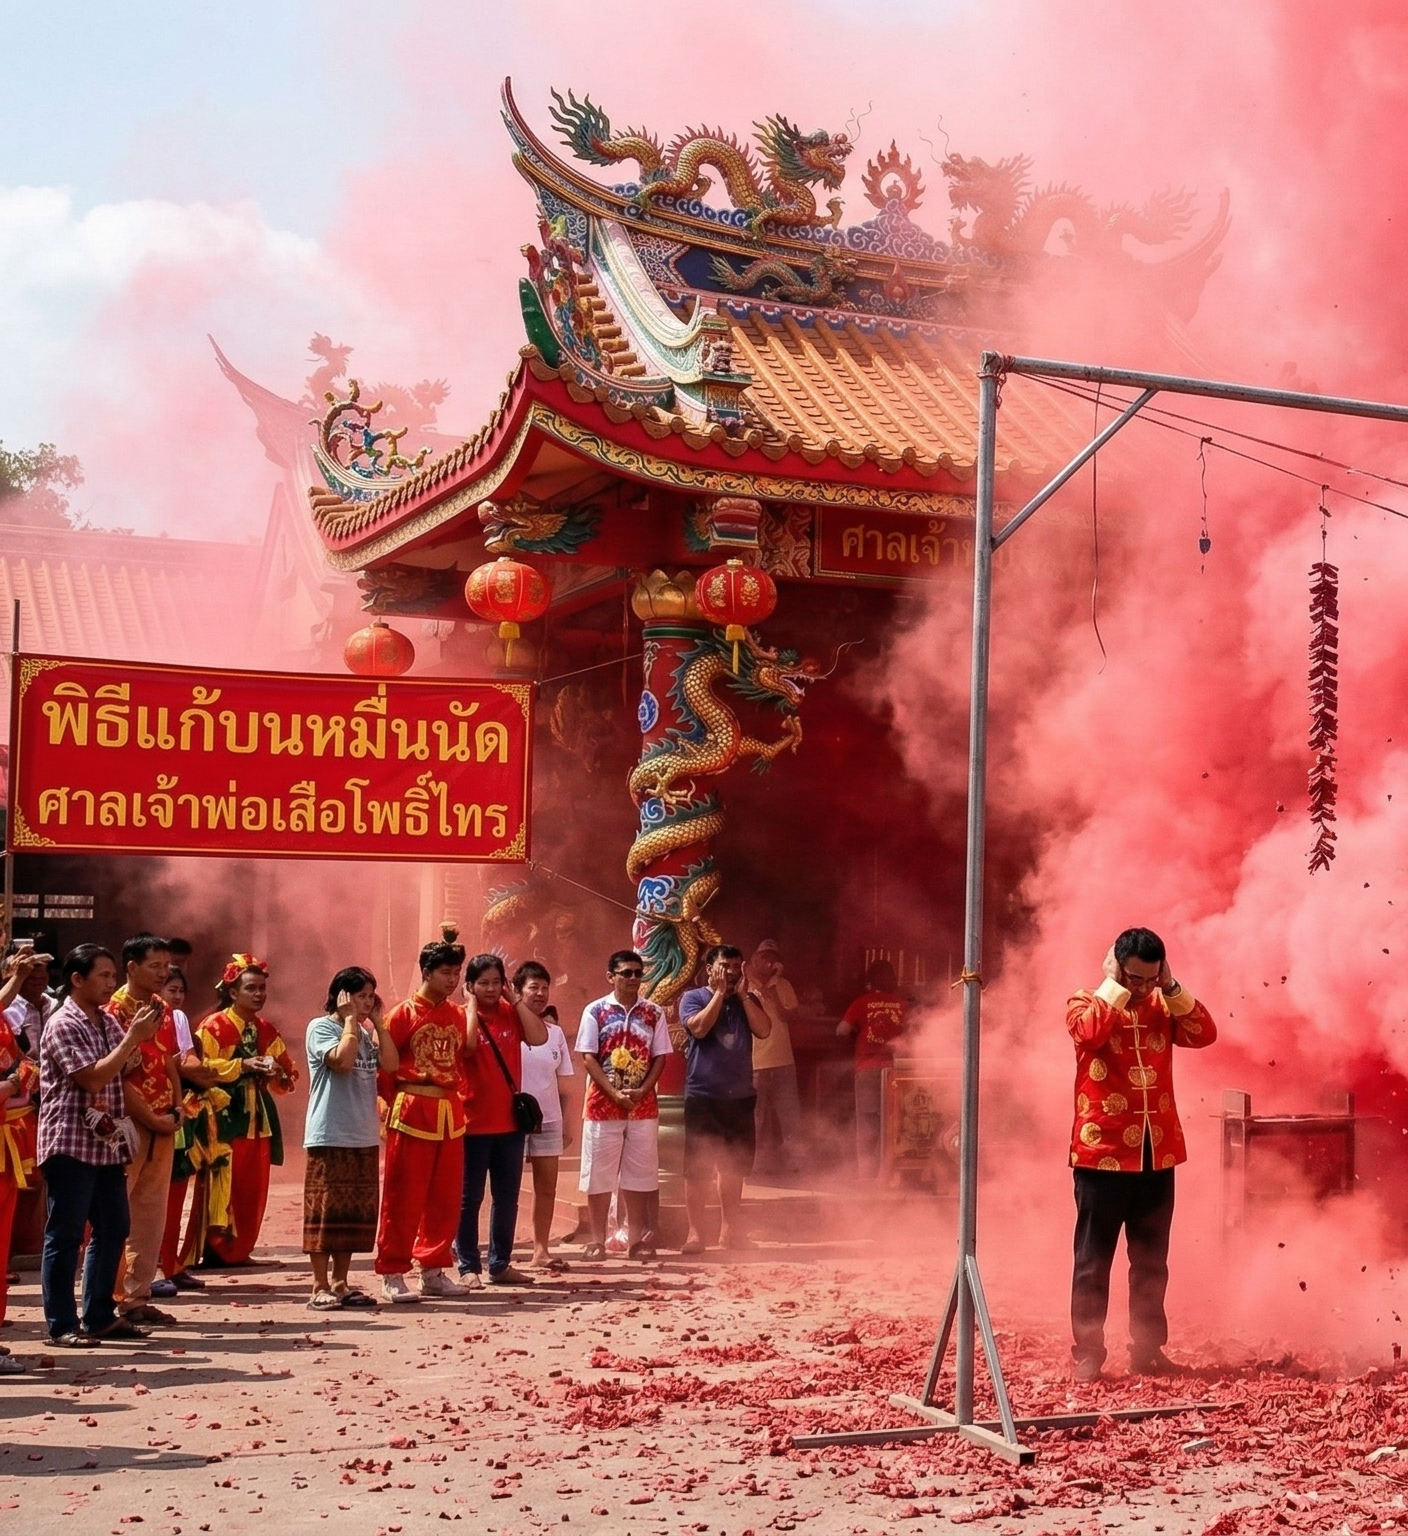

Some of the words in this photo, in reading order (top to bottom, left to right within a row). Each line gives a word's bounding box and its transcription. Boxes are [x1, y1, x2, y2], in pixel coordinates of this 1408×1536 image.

[42, 682, 508, 763] พิธีแก้บนหมื่นนัด
[38, 770, 509, 838] ศาลเจ้าพ่อเสือโพธิ์ไทร
